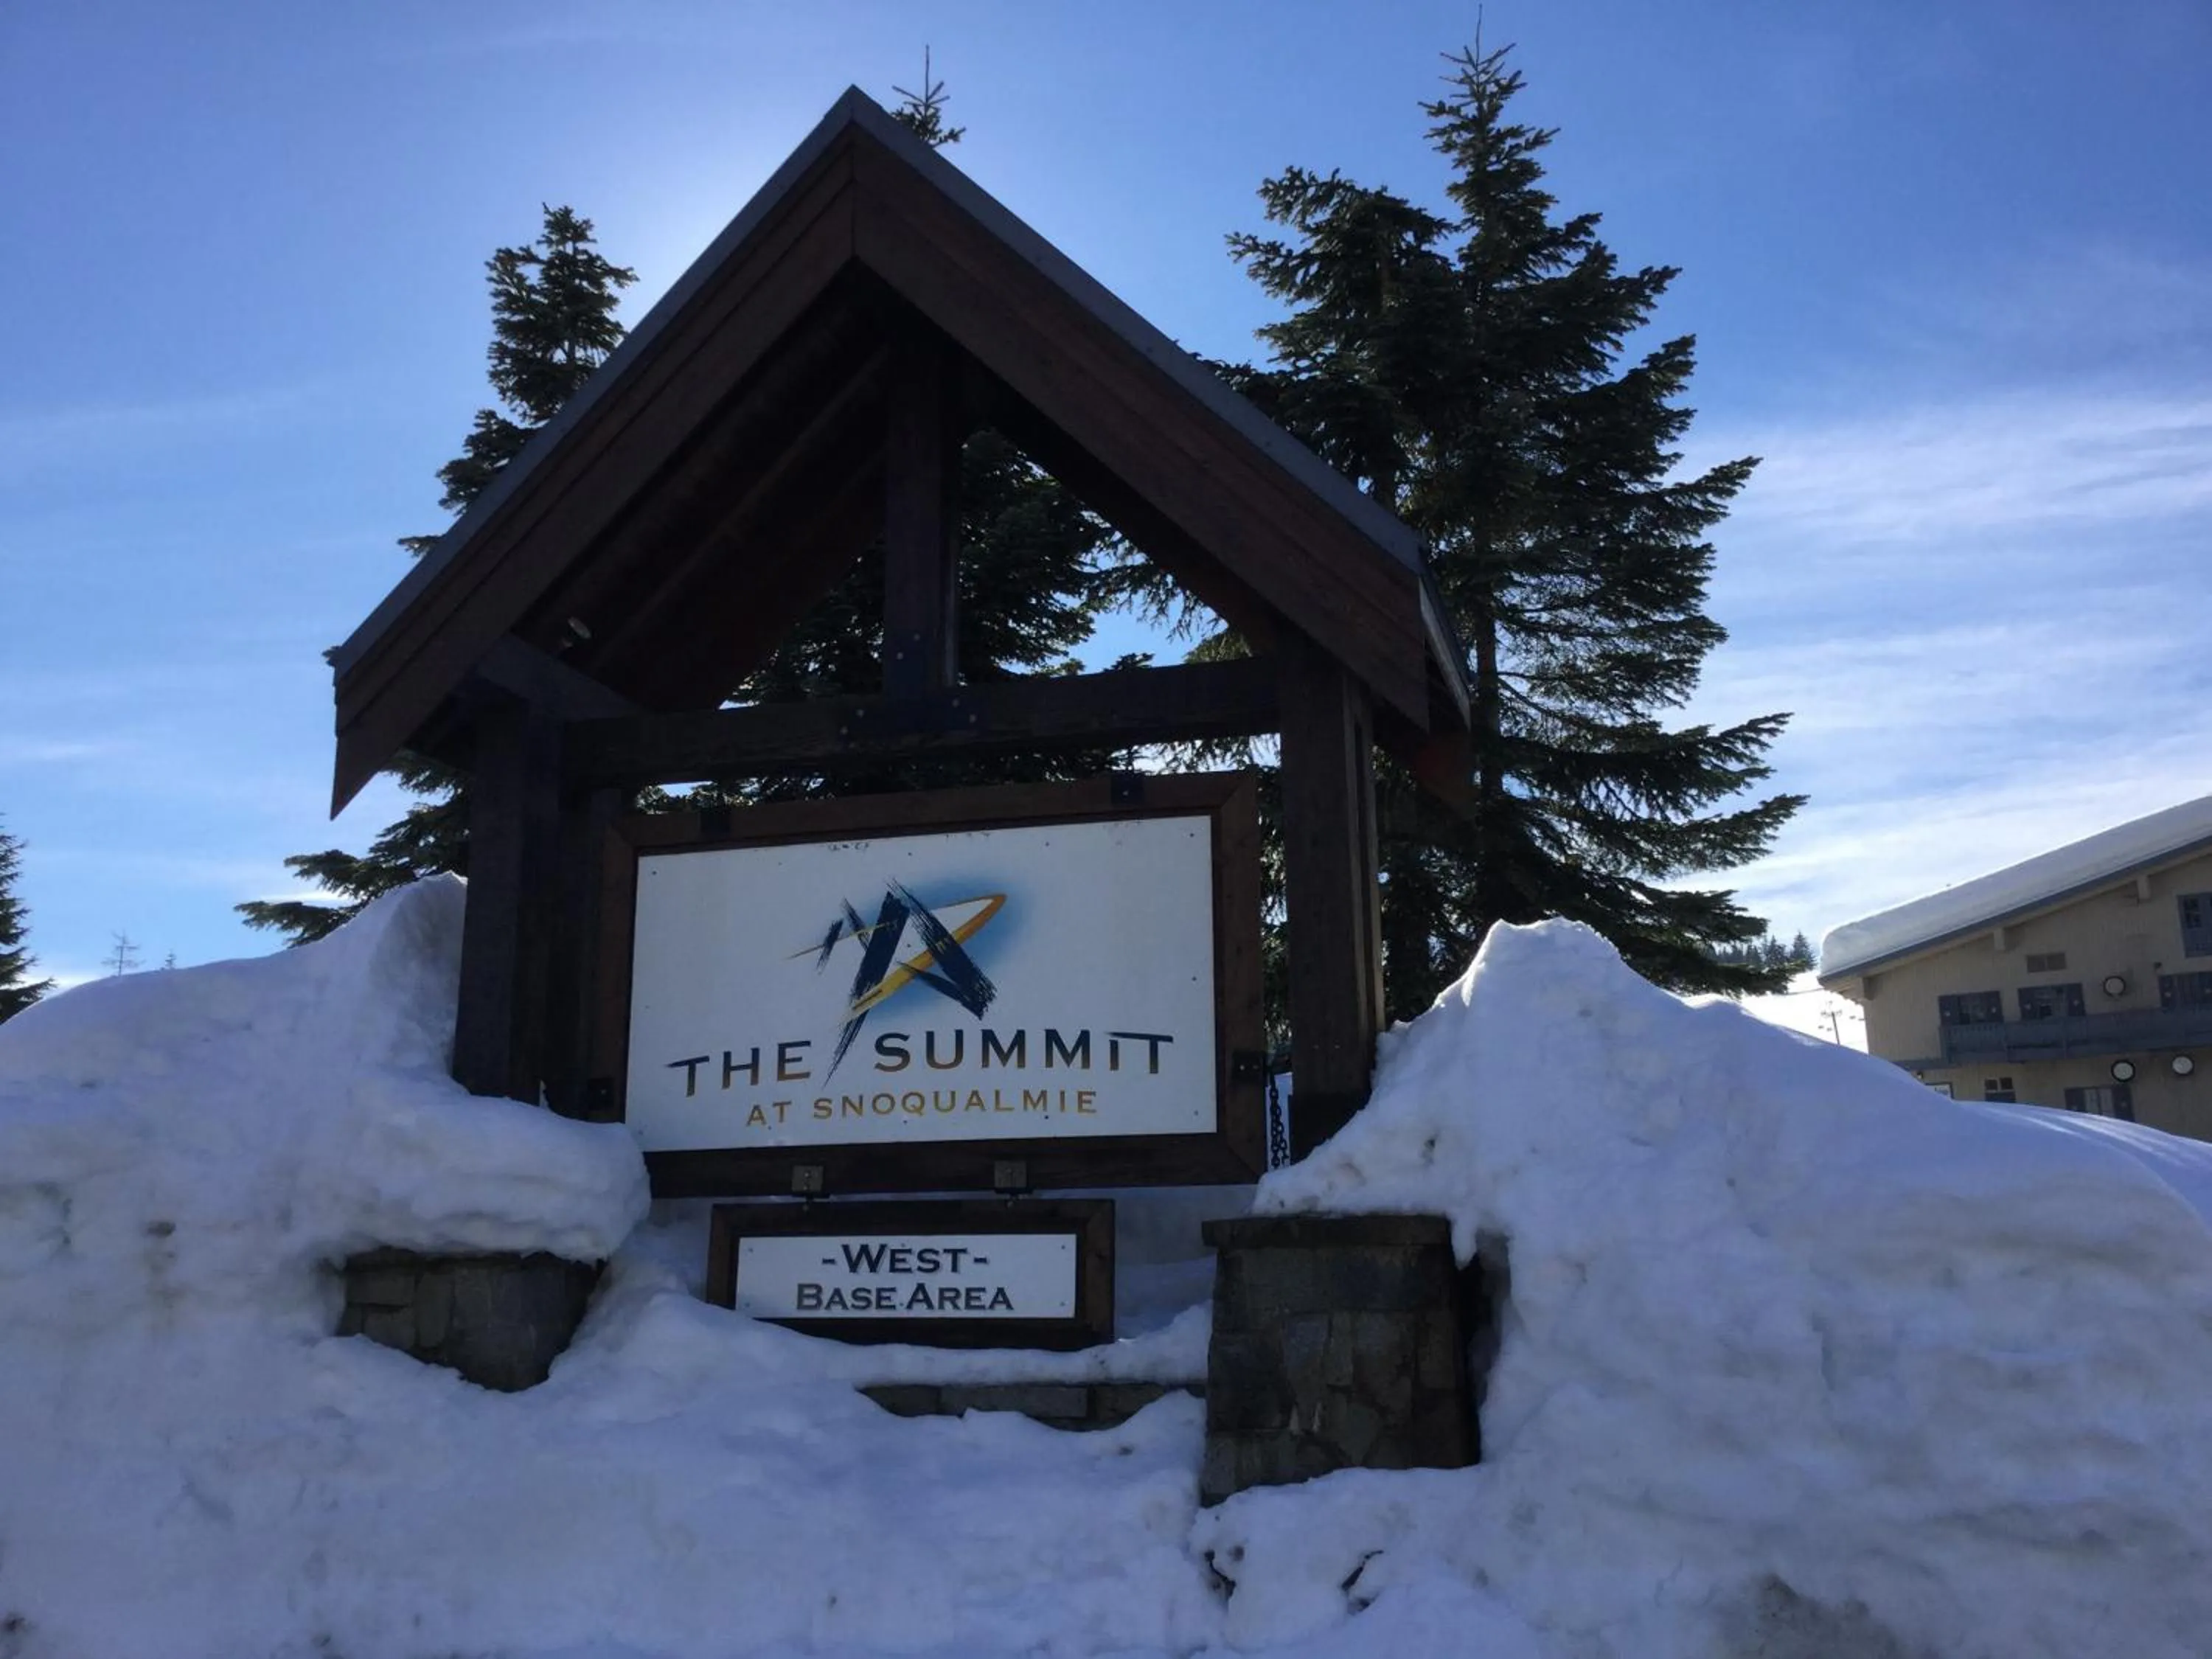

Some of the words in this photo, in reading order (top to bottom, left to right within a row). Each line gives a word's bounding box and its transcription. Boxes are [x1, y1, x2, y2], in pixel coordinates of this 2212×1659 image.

[666, 1040, 811, 1097] THE
[874, 1029, 1174, 1074] SUMMIT
[746, 1101, 793, 1127] AT
[813, 1089, 1097, 1119] SNOQUALMIE
[796, 1283, 897, 1311] BASE
[906, 1282, 1014, 1311] AREA
